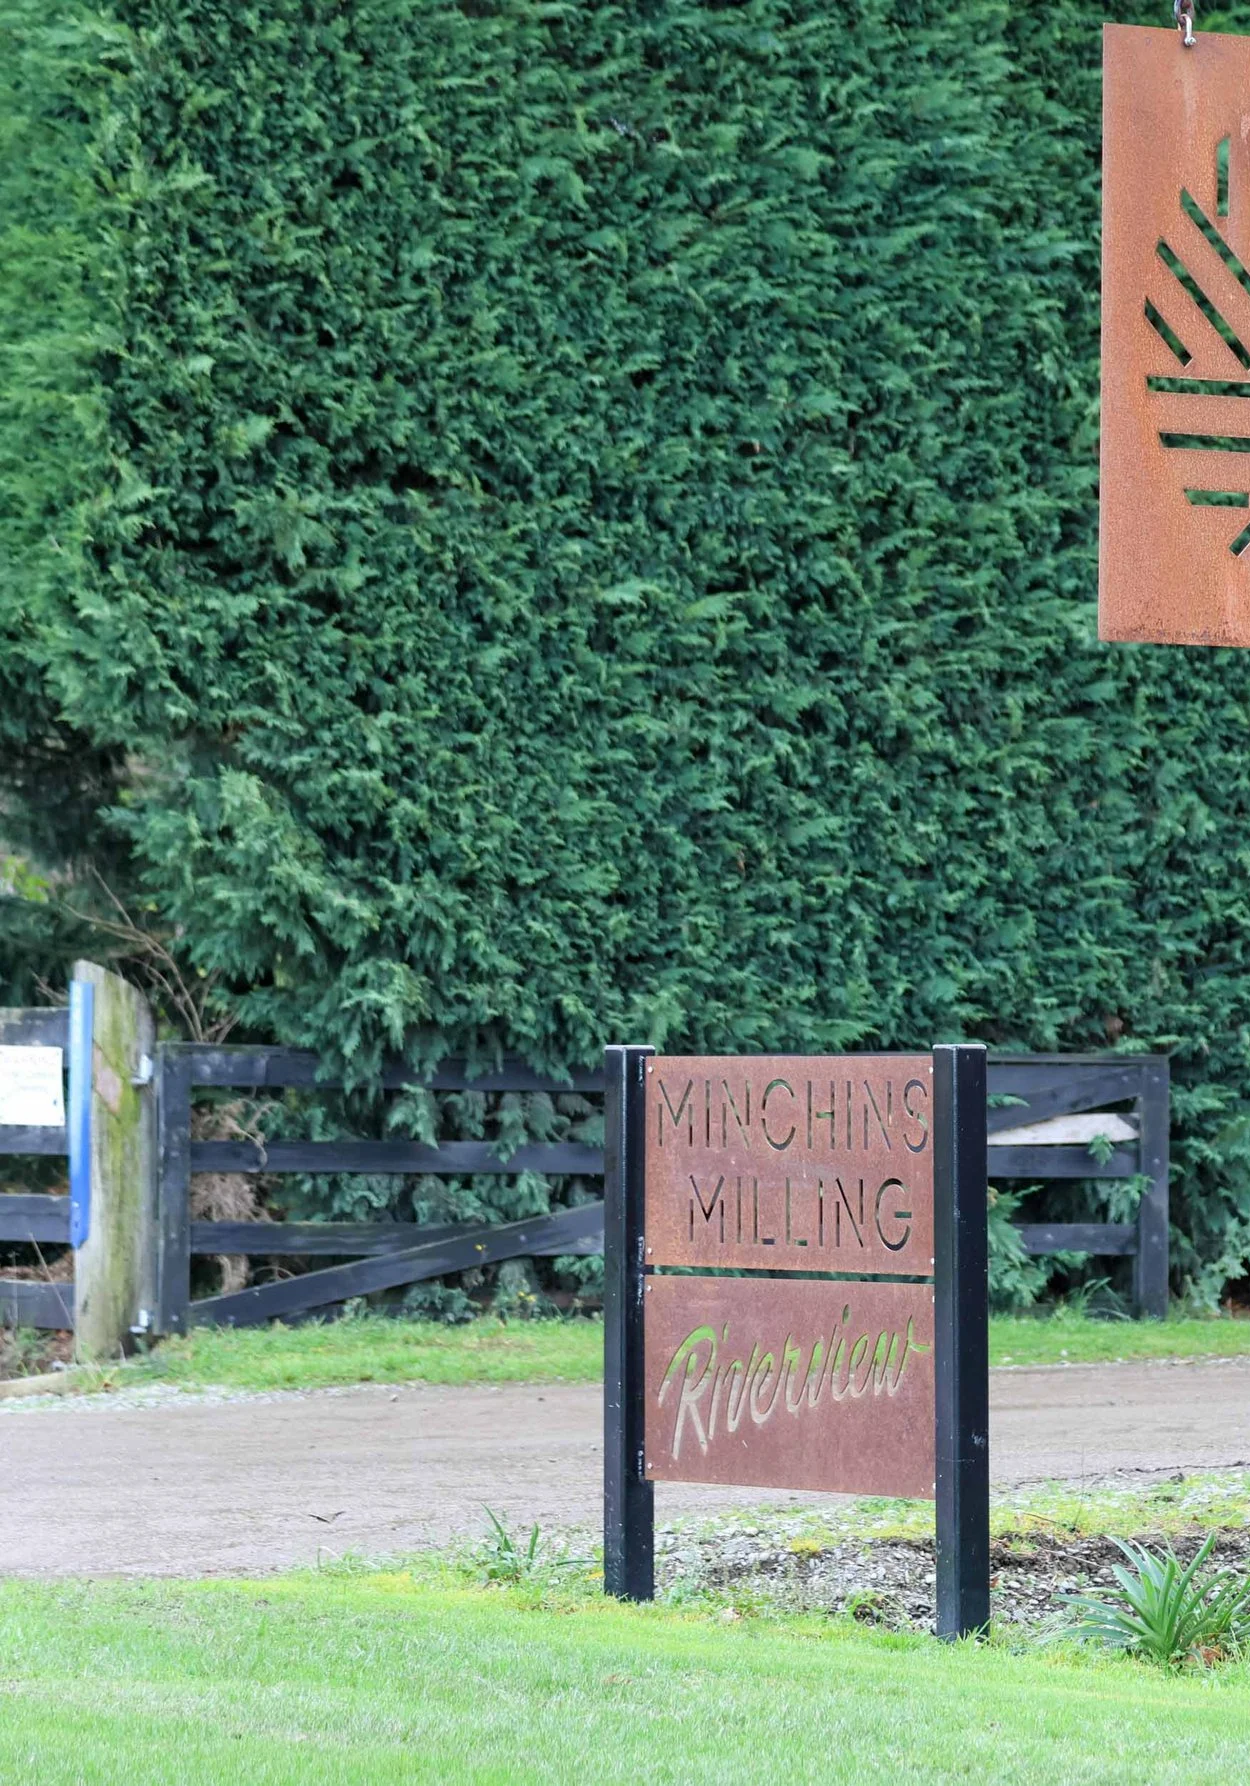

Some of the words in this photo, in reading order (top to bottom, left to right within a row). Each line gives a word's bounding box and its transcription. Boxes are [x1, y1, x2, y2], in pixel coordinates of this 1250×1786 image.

[657, 1078, 928, 1153] MINCHINS
[689, 1175, 912, 1251] MILLING
[659, 1303, 931, 1460] Riverview
